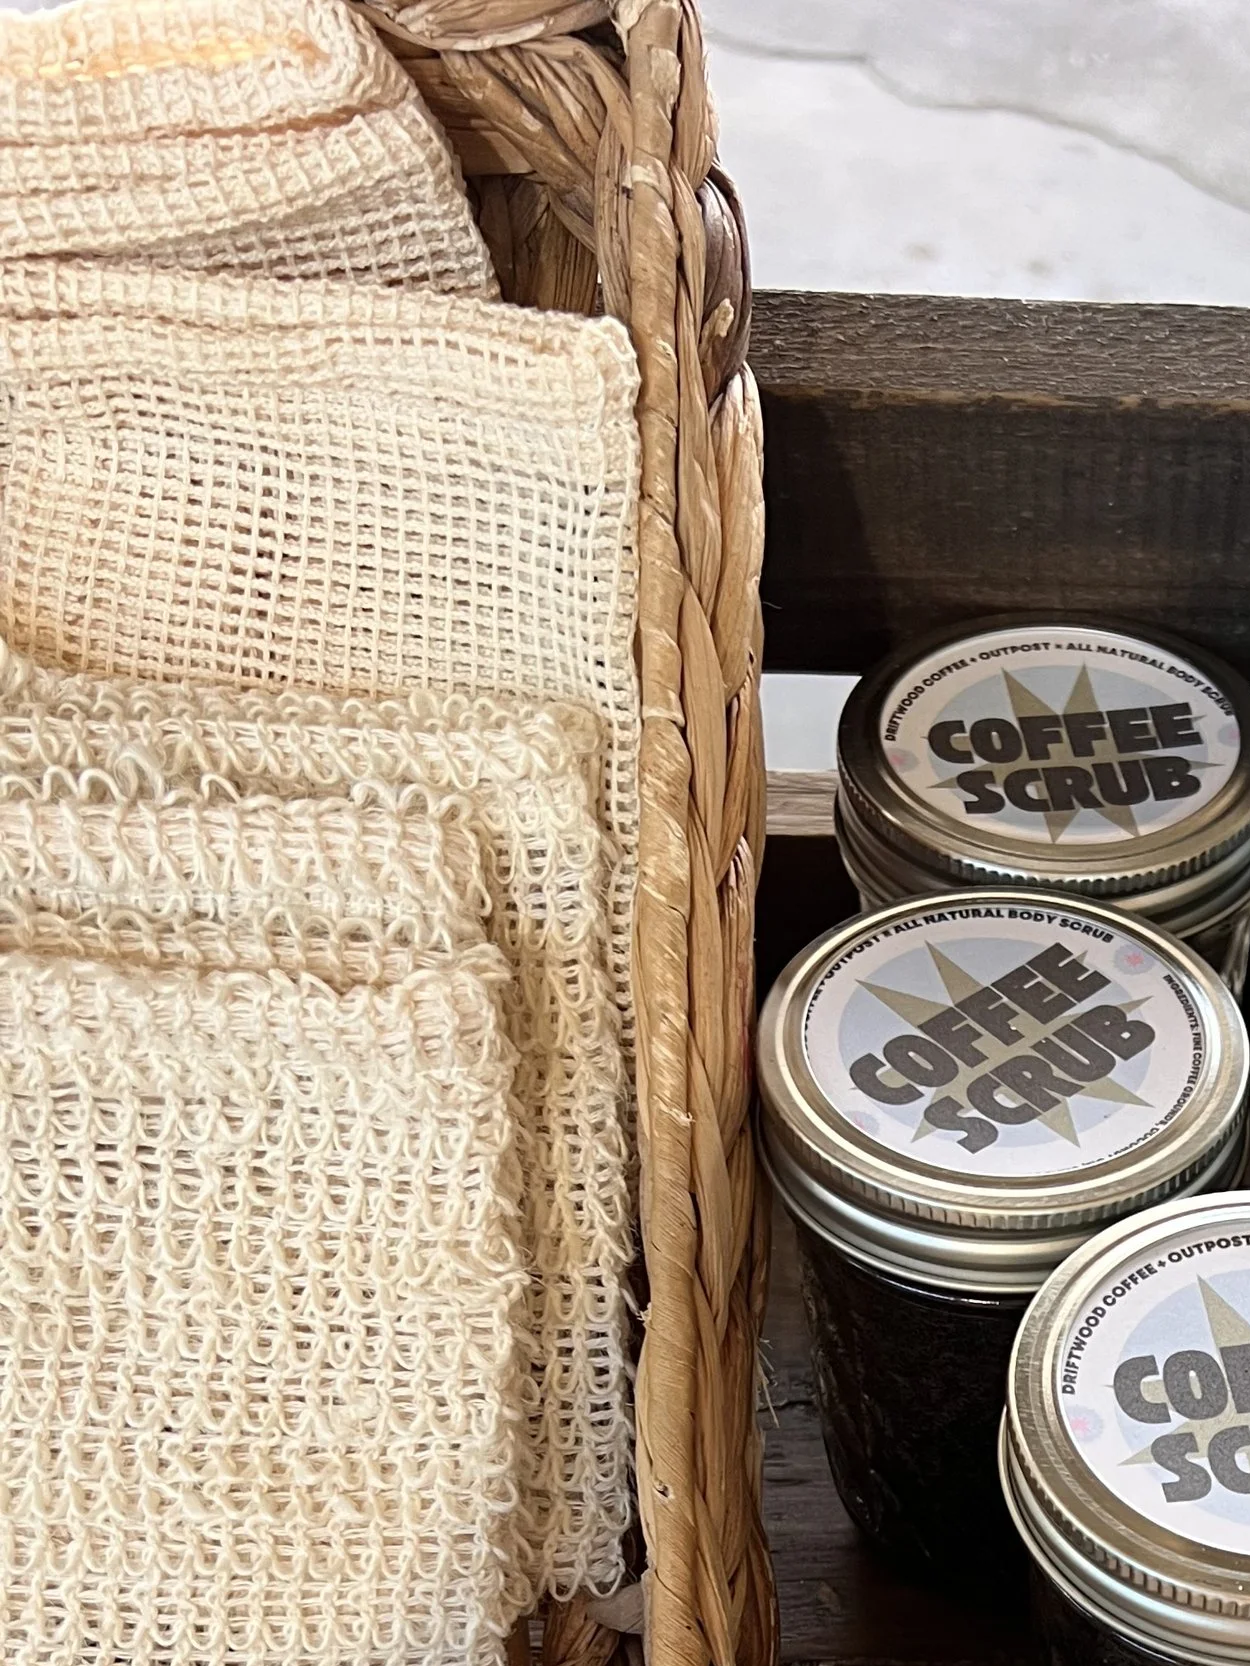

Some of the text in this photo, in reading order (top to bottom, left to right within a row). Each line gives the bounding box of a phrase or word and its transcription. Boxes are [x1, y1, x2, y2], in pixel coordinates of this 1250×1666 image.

[885, 685, 926, 742] DRIFTWOOD
[922, 659, 970, 687] COFFEE
[979, 642, 1051, 661] OUTPOST
[1066, 642, 1093, 652] ALL
[1097, 645, 1166, 671] NATURAL
[1167, 665, 1204, 688] BODY
[928, 702, 1203, 765] COFFEE
[955, 756, 1202, 815] SCRUB
[893, 919, 922, 936] ALL
[923, 908, 1004, 926] NATURAL
[1008, 909, 1057, 925] BODY
[1058, 918, 1115, 944] SCRUB
[849, 942, 1112, 1106] COFFEE
[924, 1004, 1156, 1154] SCRUB
[1062, 1306, 1107, 1396] DRIFTWOOD
[1102, 1263, 1159, 1307] COFFEE
